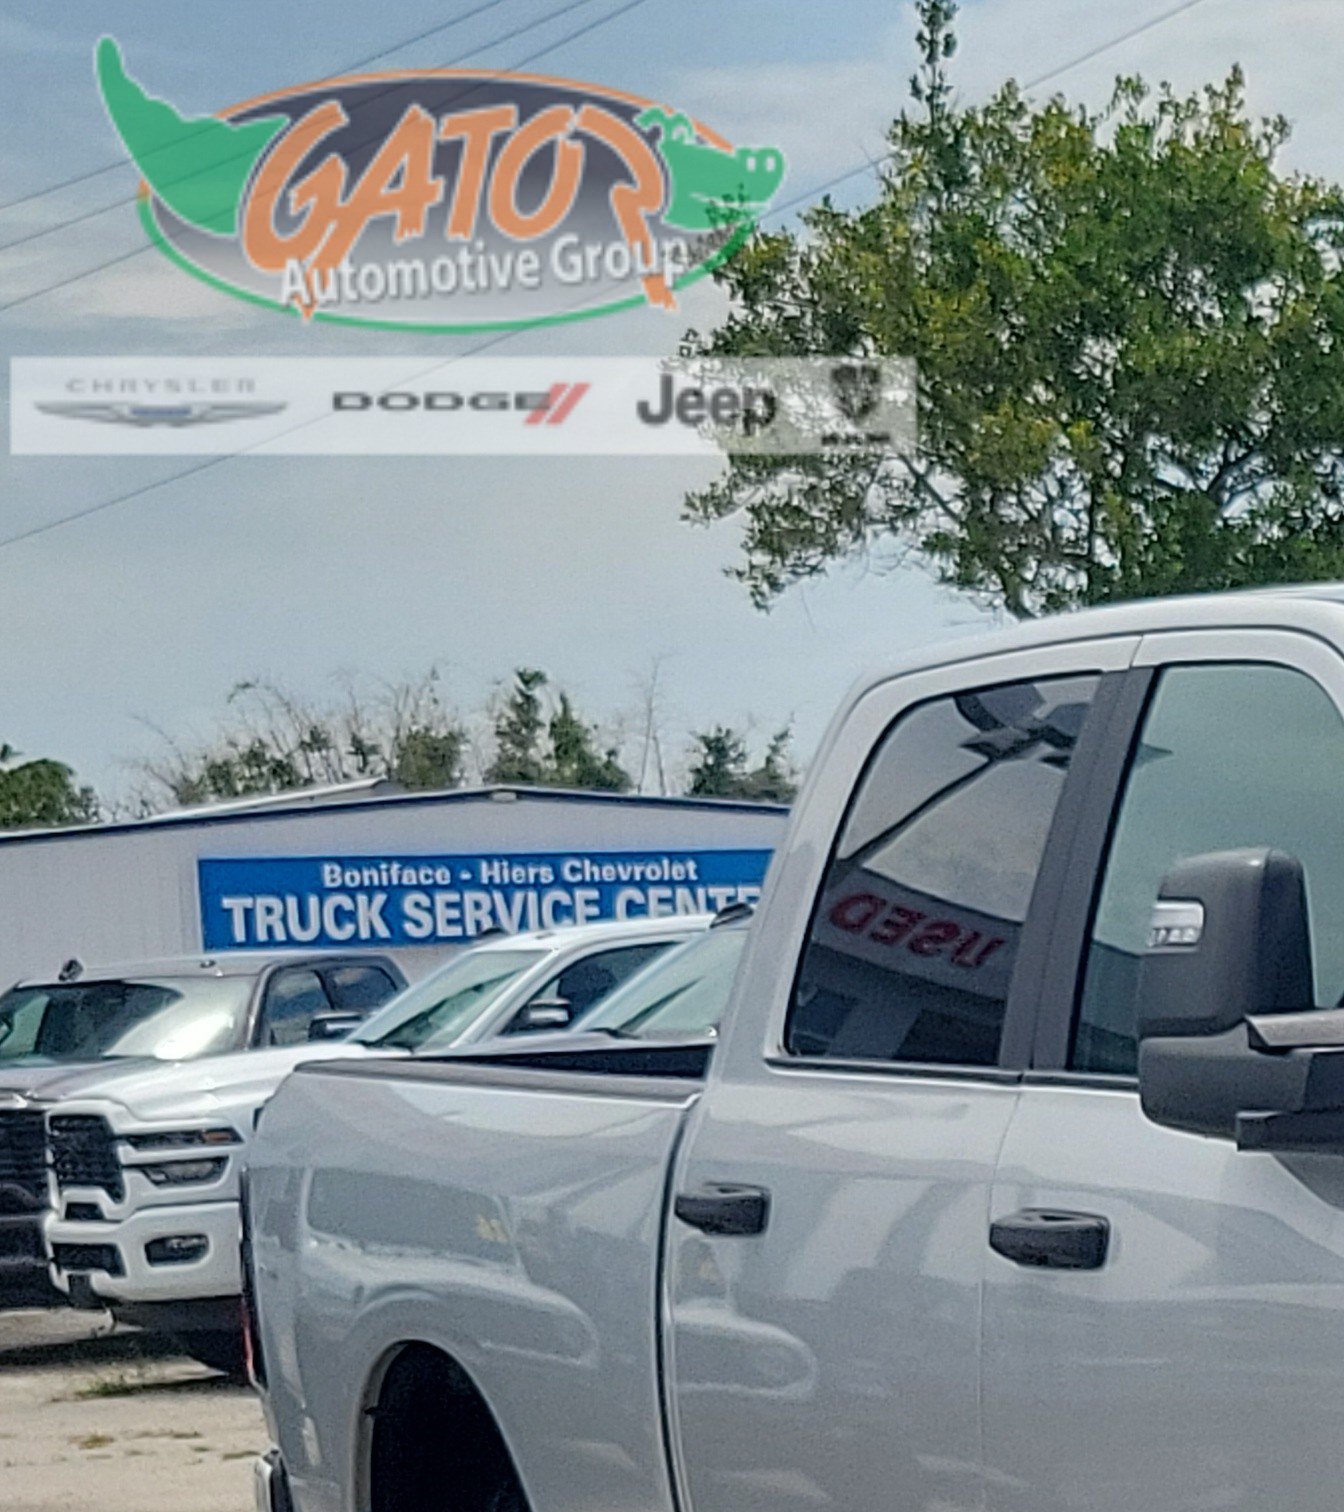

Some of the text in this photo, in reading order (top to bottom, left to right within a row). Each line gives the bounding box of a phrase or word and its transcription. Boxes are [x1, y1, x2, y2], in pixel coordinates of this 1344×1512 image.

[323, 863, 451, 888] Boniface
[480, 860, 554, 885] Hiers
[561, 857, 698, 883] Chevrolet
[221, 893, 390, 943] TRUCK
[403, 886, 599, 938] SERVICE
